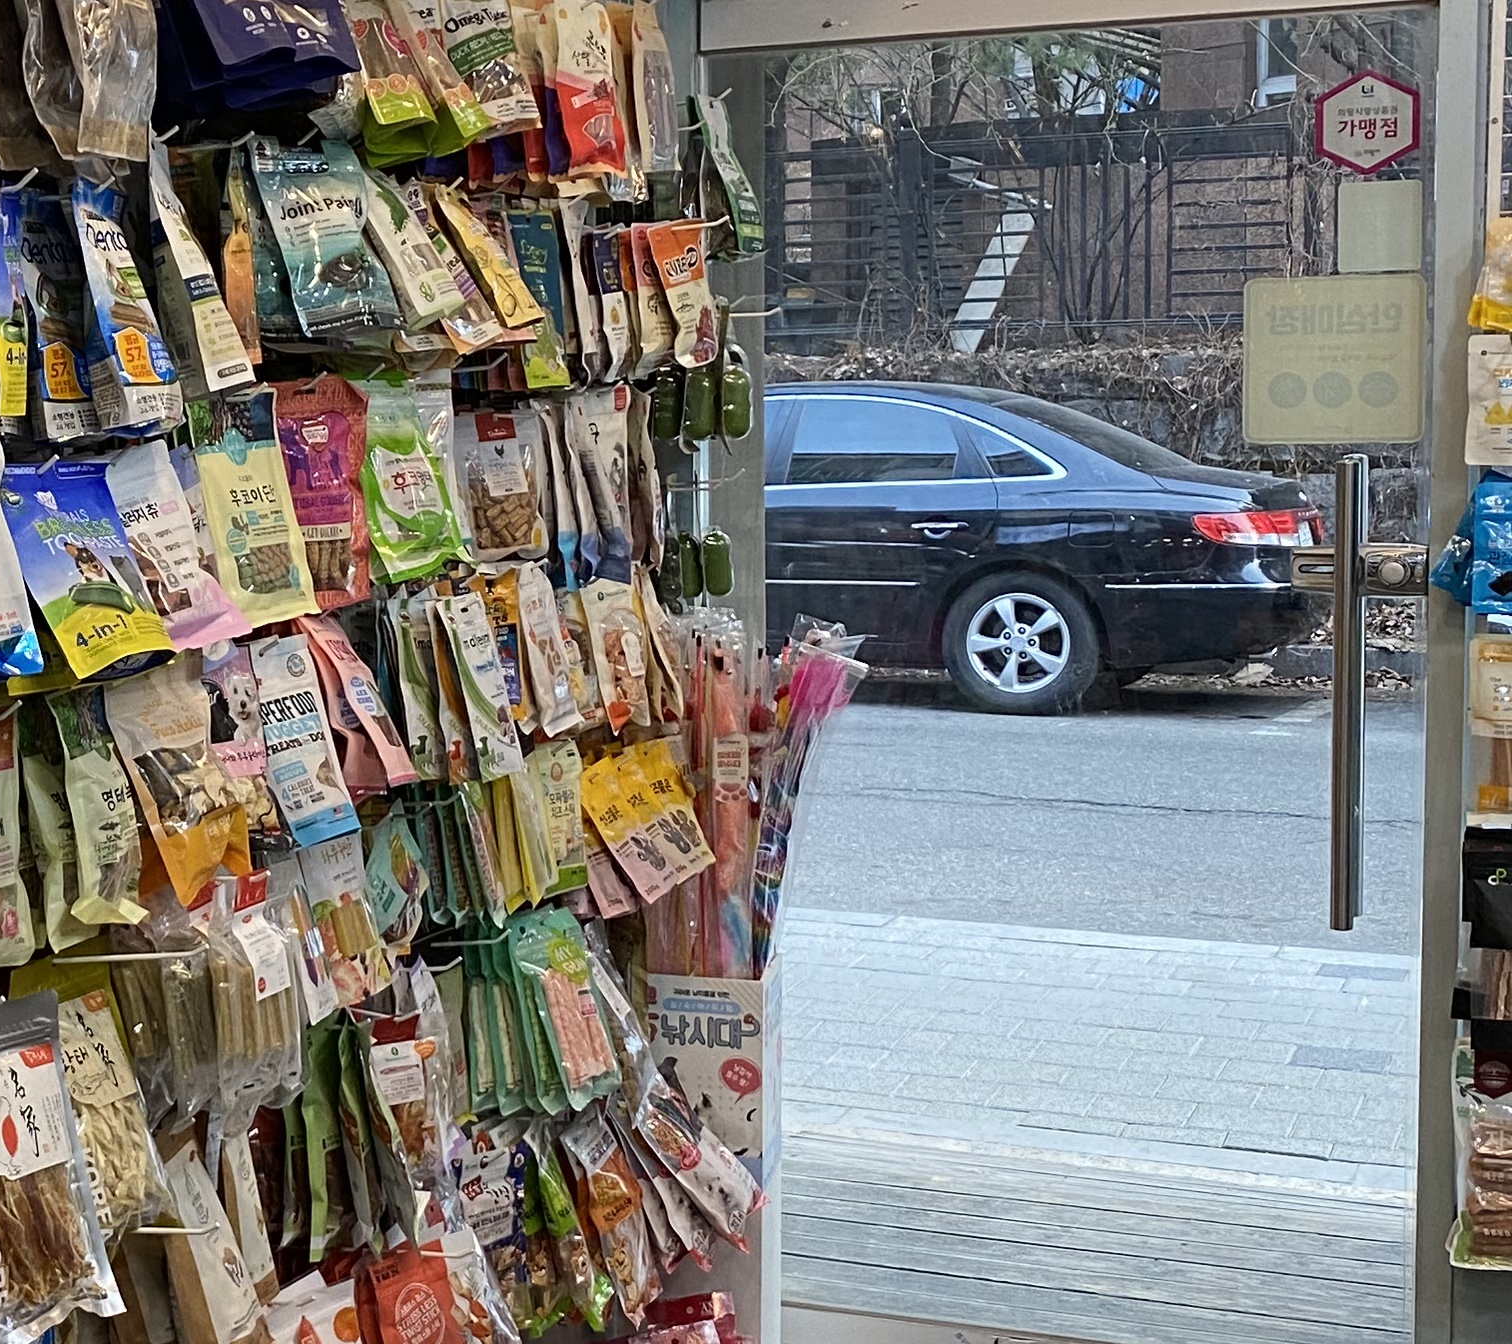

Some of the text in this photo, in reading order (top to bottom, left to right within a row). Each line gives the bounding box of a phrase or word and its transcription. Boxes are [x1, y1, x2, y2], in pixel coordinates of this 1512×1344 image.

[1337, 118, 1399, 140] 가맹점
[279, 199, 323, 222] Joint
[229, 485, 277, 507] 후코이단
[42, 532, 125, 556] TOOPASTE
[75, 614, 128, 648] 4-in-1
[259, 690, 319, 725] PERFOOD
